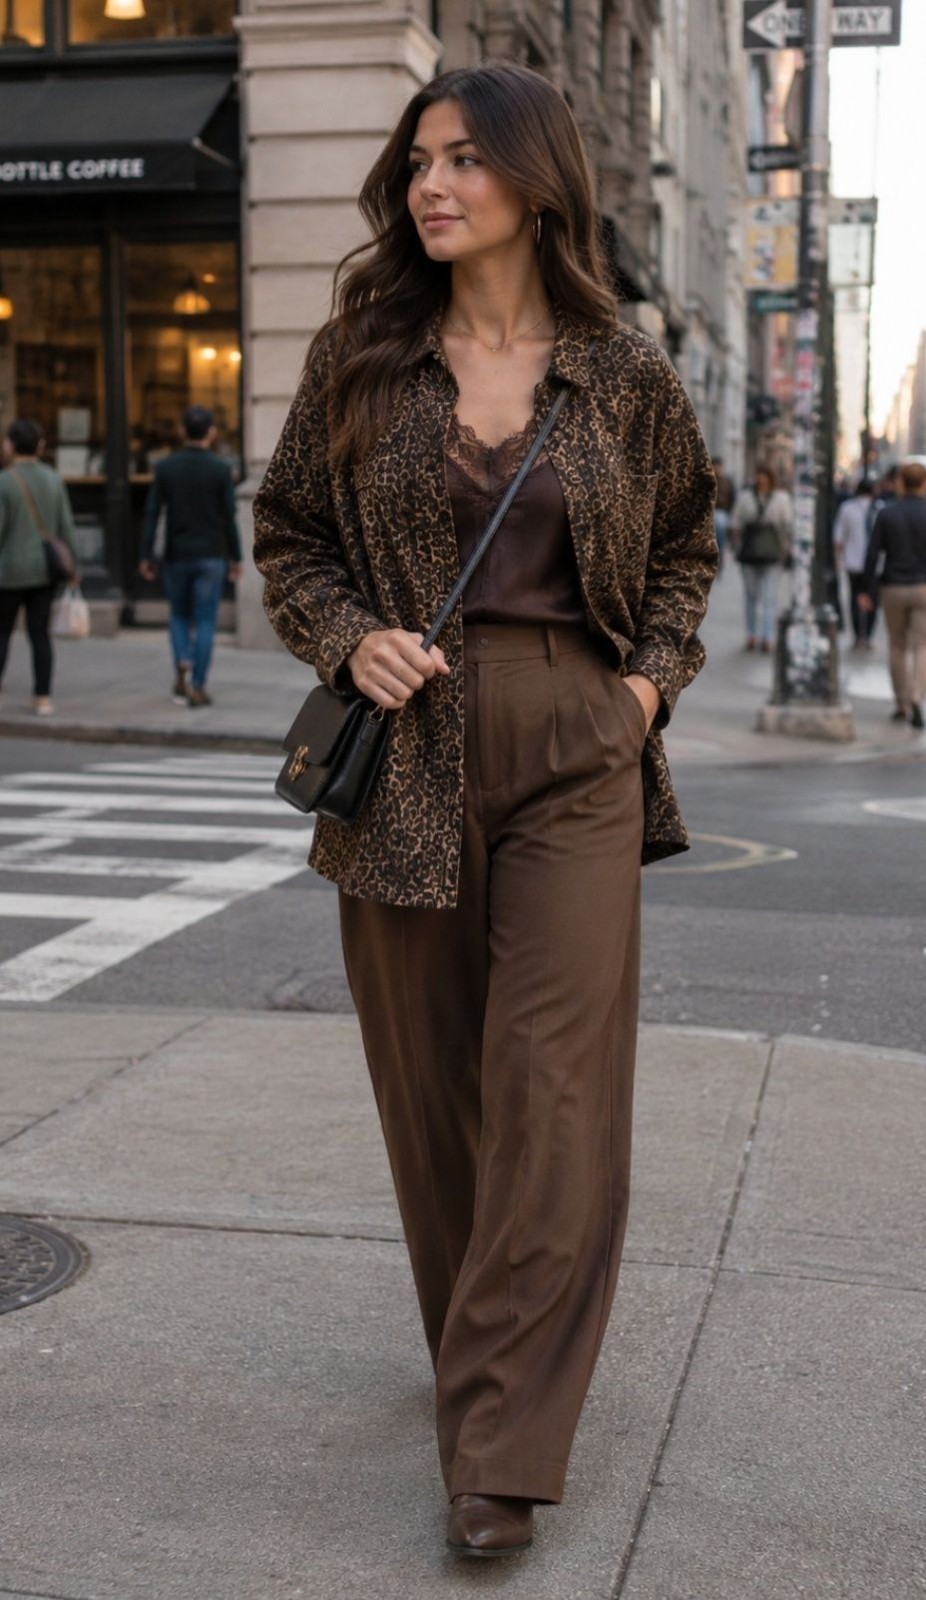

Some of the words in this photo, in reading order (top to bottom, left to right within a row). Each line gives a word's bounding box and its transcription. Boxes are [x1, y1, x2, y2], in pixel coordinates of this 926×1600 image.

[837, 12, 882, 30] WAY
[0, 161, 62, 181] OTTLE
[66, 158, 144, 179] COFFEE
